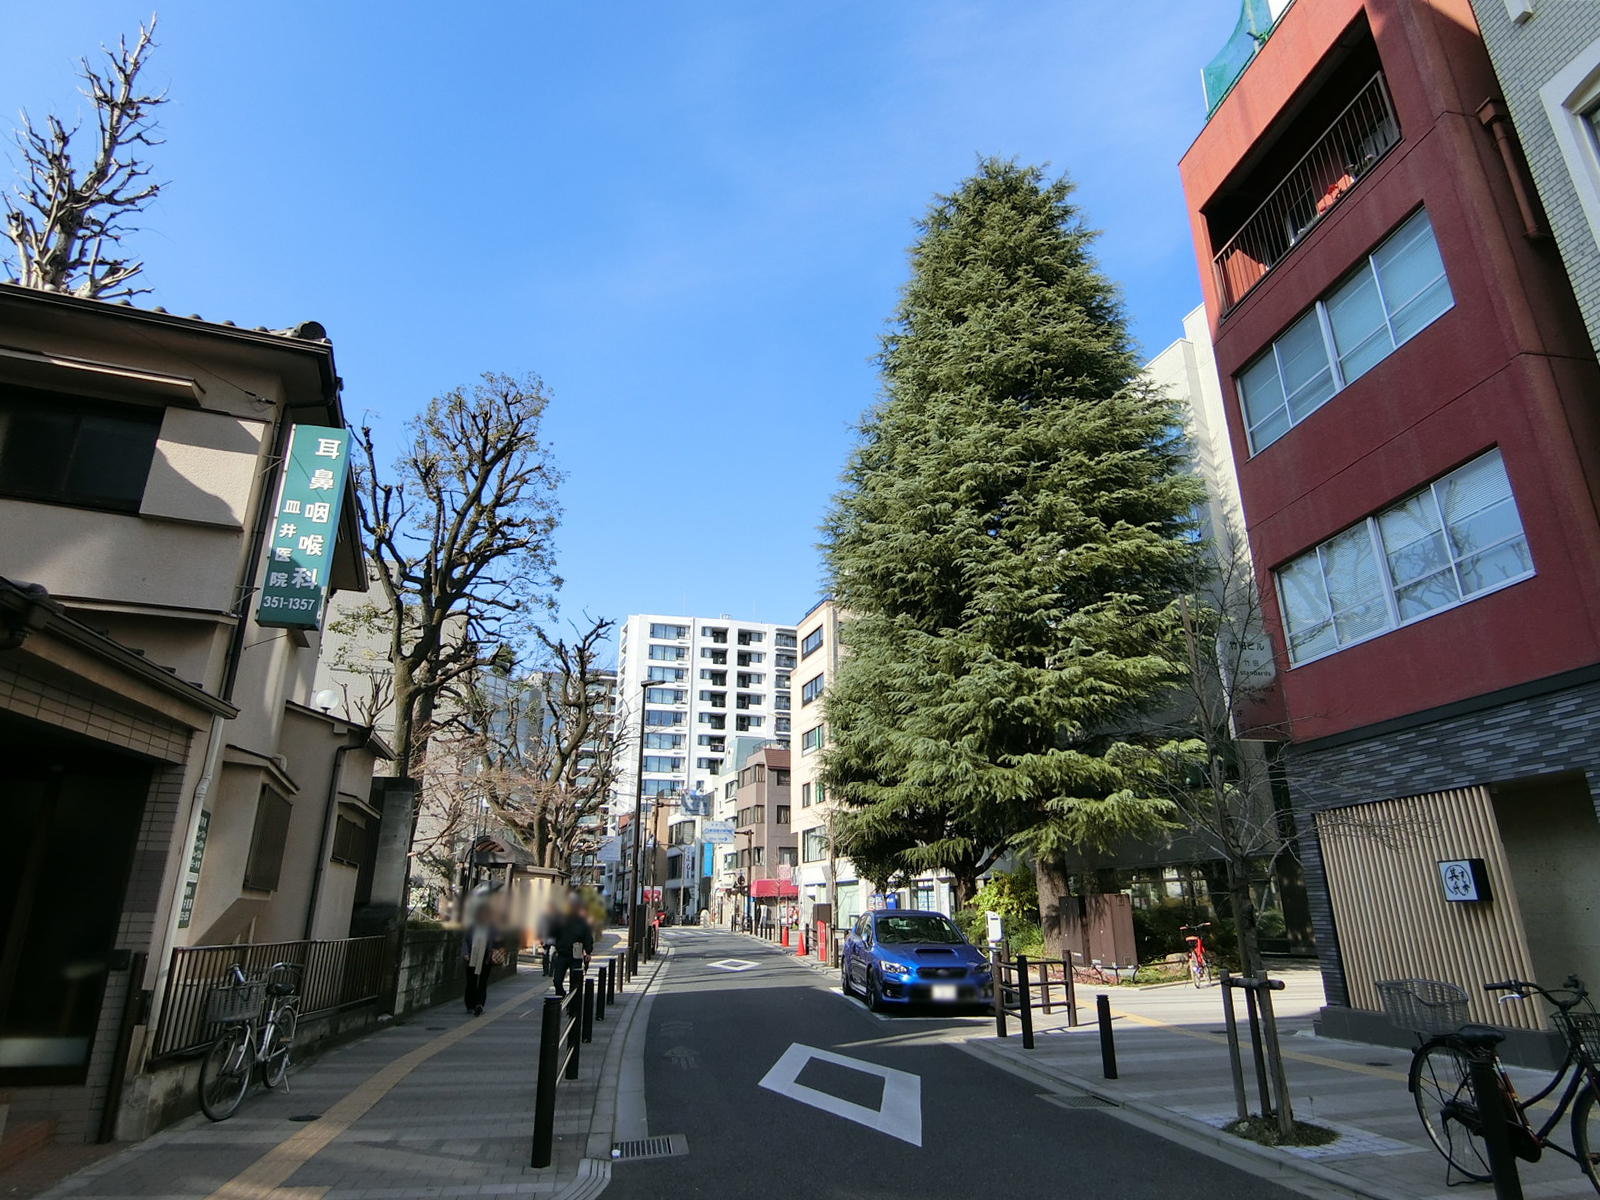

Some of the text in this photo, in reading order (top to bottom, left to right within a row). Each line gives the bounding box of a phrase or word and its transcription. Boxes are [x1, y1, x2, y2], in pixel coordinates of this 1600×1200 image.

[269, 499, 301, 588] 皿井医院
[291, 438, 342, 590] 耳鼻咽喉科
[263, 596, 315, 611] 351-1357
